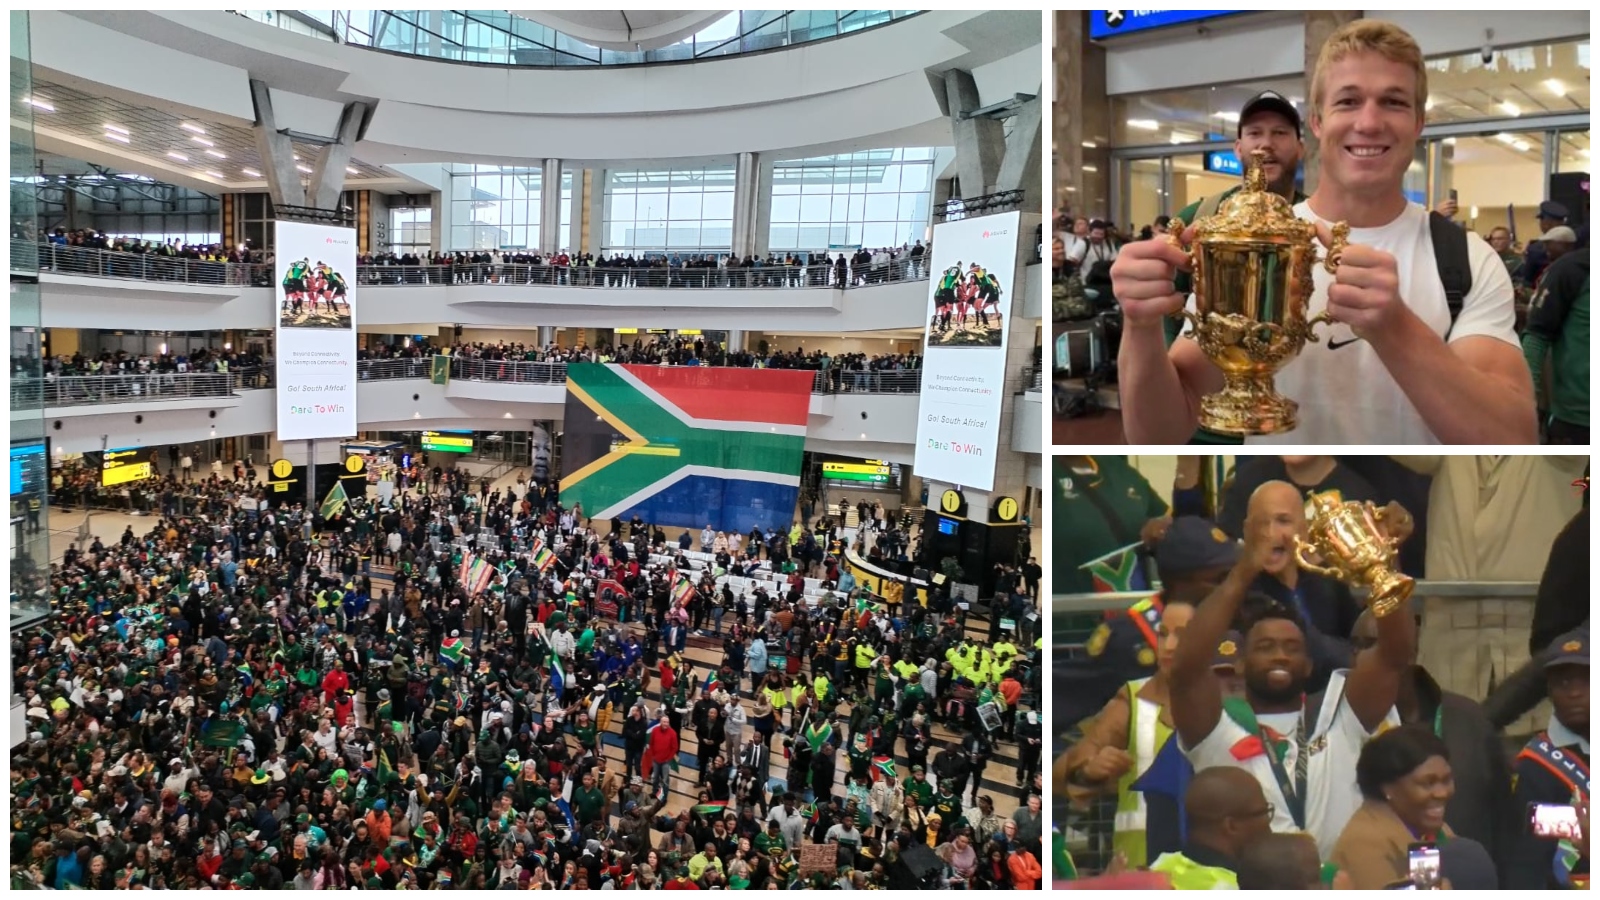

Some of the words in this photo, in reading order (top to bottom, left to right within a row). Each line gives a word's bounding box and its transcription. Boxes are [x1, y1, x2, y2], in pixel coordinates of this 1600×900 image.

[291, 406, 312, 414] Dare
[315, 405, 326, 413] To
[328, 404, 344, 413] Win
[928, 414, 940, 422] Go!
[941, 415, 960, 425] South
[962, 418, 987, 428] Africa!
[928, 438, 949, 451] Dare
[951, 442, 961, 453] To
[964, 443, 982, 456] Win
